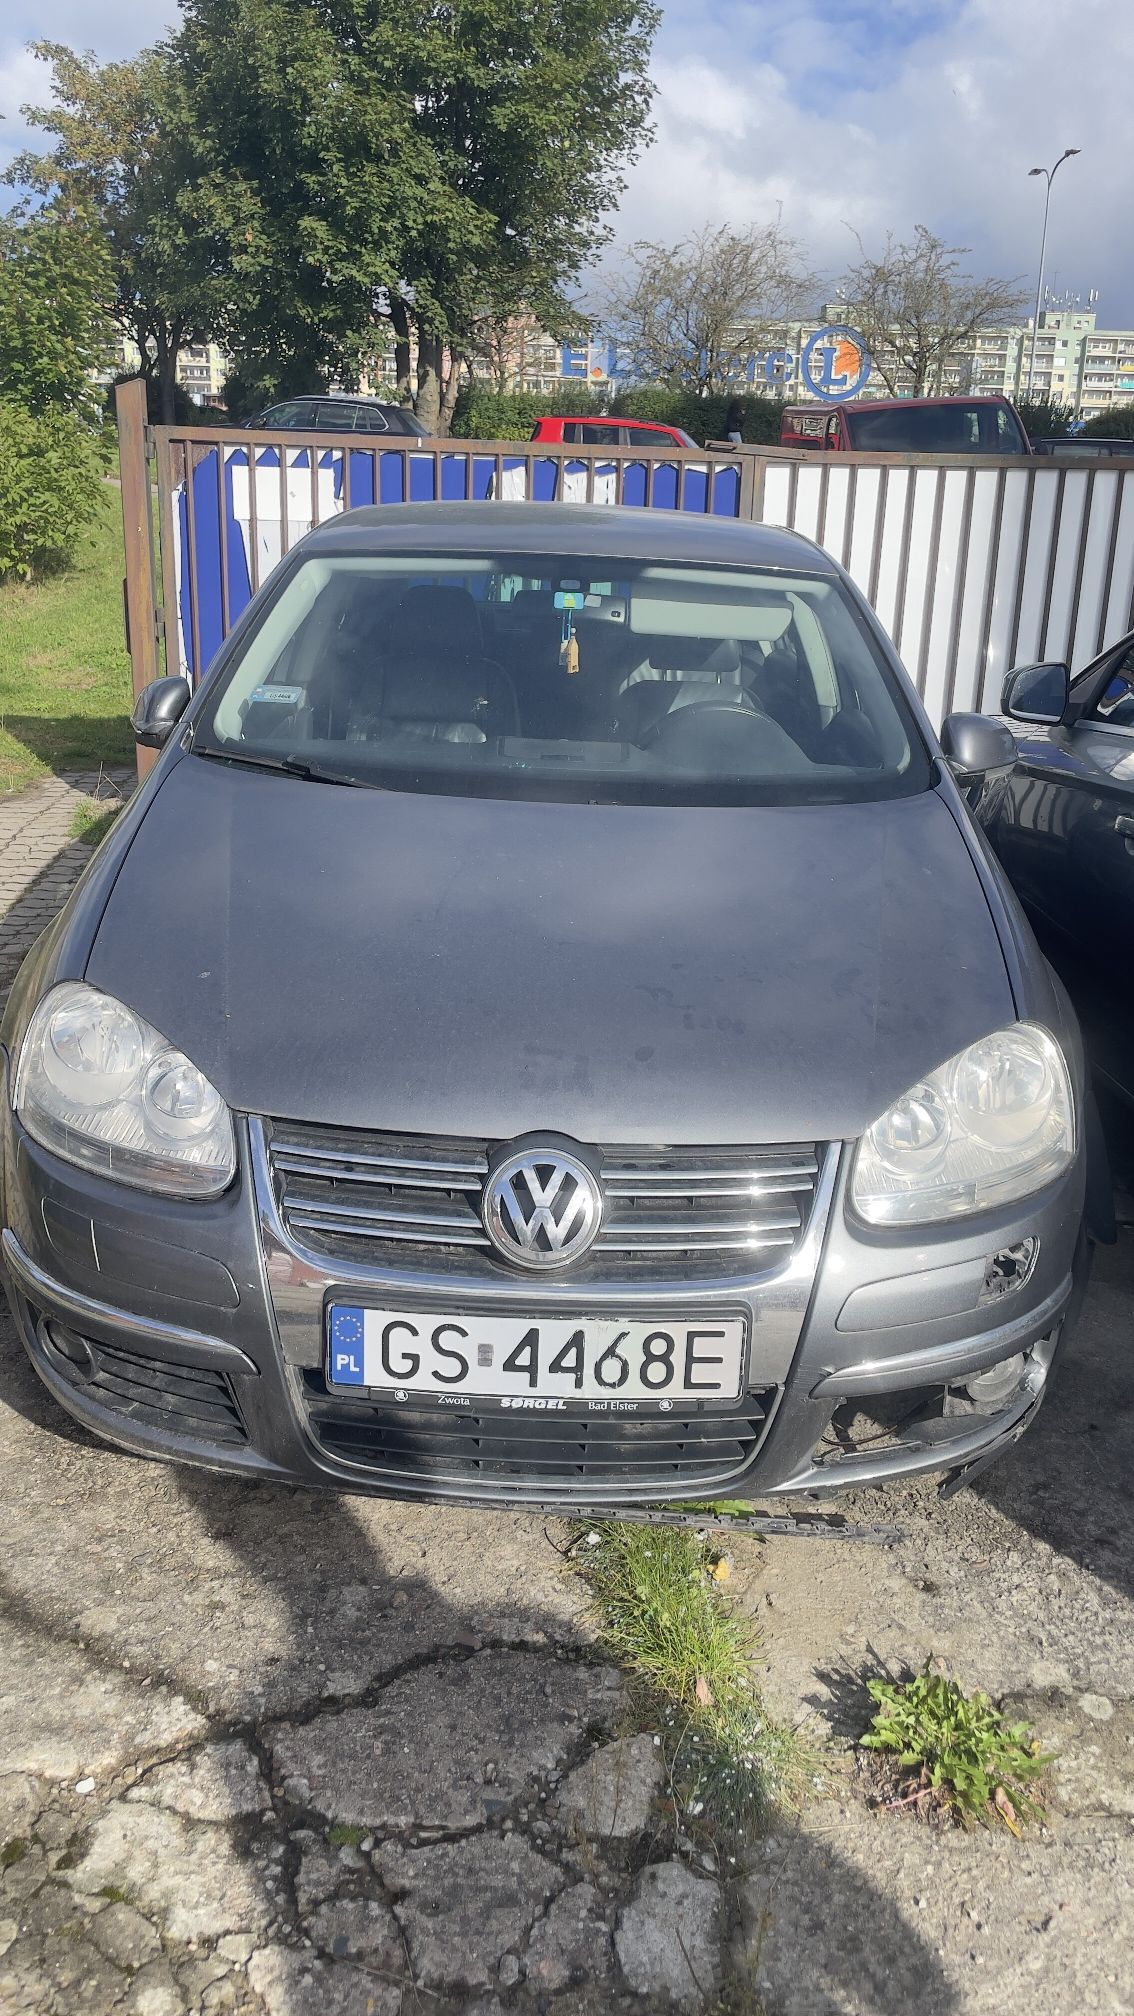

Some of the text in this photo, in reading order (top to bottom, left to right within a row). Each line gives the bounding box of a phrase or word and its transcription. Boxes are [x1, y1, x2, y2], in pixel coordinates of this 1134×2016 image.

[336, 1353, 360, 1372] PL
[381, 1320, 726, 1390] GS 4468E
[437, 1395, 470, 1406] Zwota
[588, 1401, 608, 1411] Bad
[610, 1401, 639, 1411] Elster
